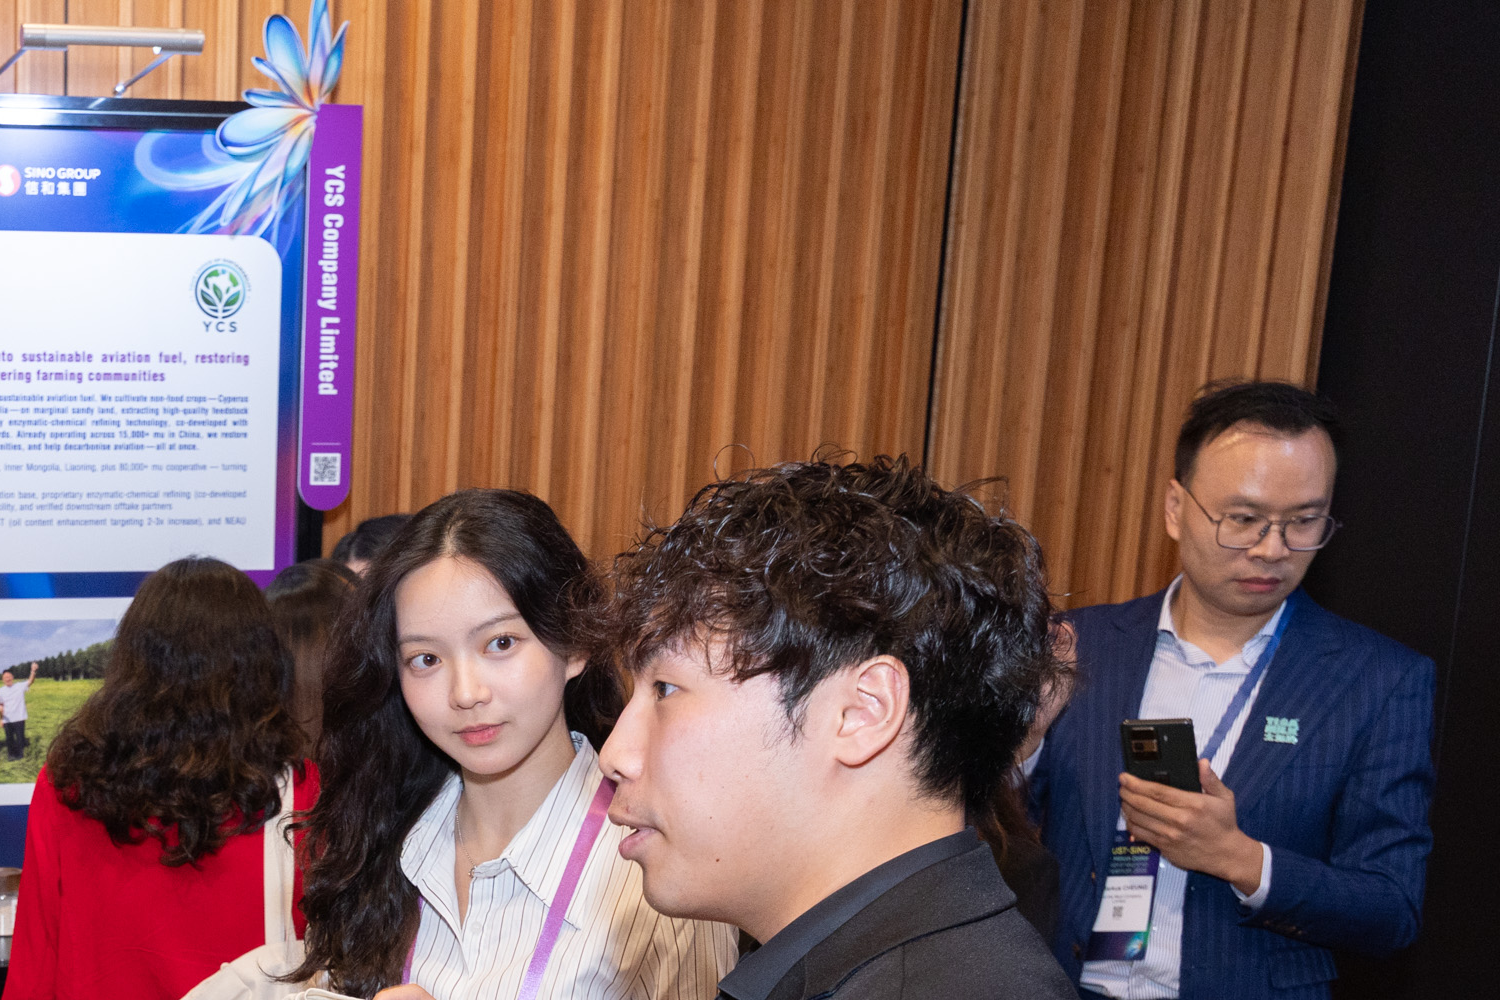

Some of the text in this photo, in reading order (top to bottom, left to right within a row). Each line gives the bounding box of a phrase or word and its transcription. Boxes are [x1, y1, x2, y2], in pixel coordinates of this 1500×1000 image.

[24, 167, 101, 180] SINO GROUP
[317, 165, 346, 395] YCS Company Limited
[203, 321, 238, 333] YCS
[22, 352, 93, 363] sustainable
[101, 352, 151, 362] aviation
[158, 353, 187, 364] fuel,
[195, 353, 250, 366] restoring
[36, 370, 83, 384] farming
[88, 370, 166, 381] communities
